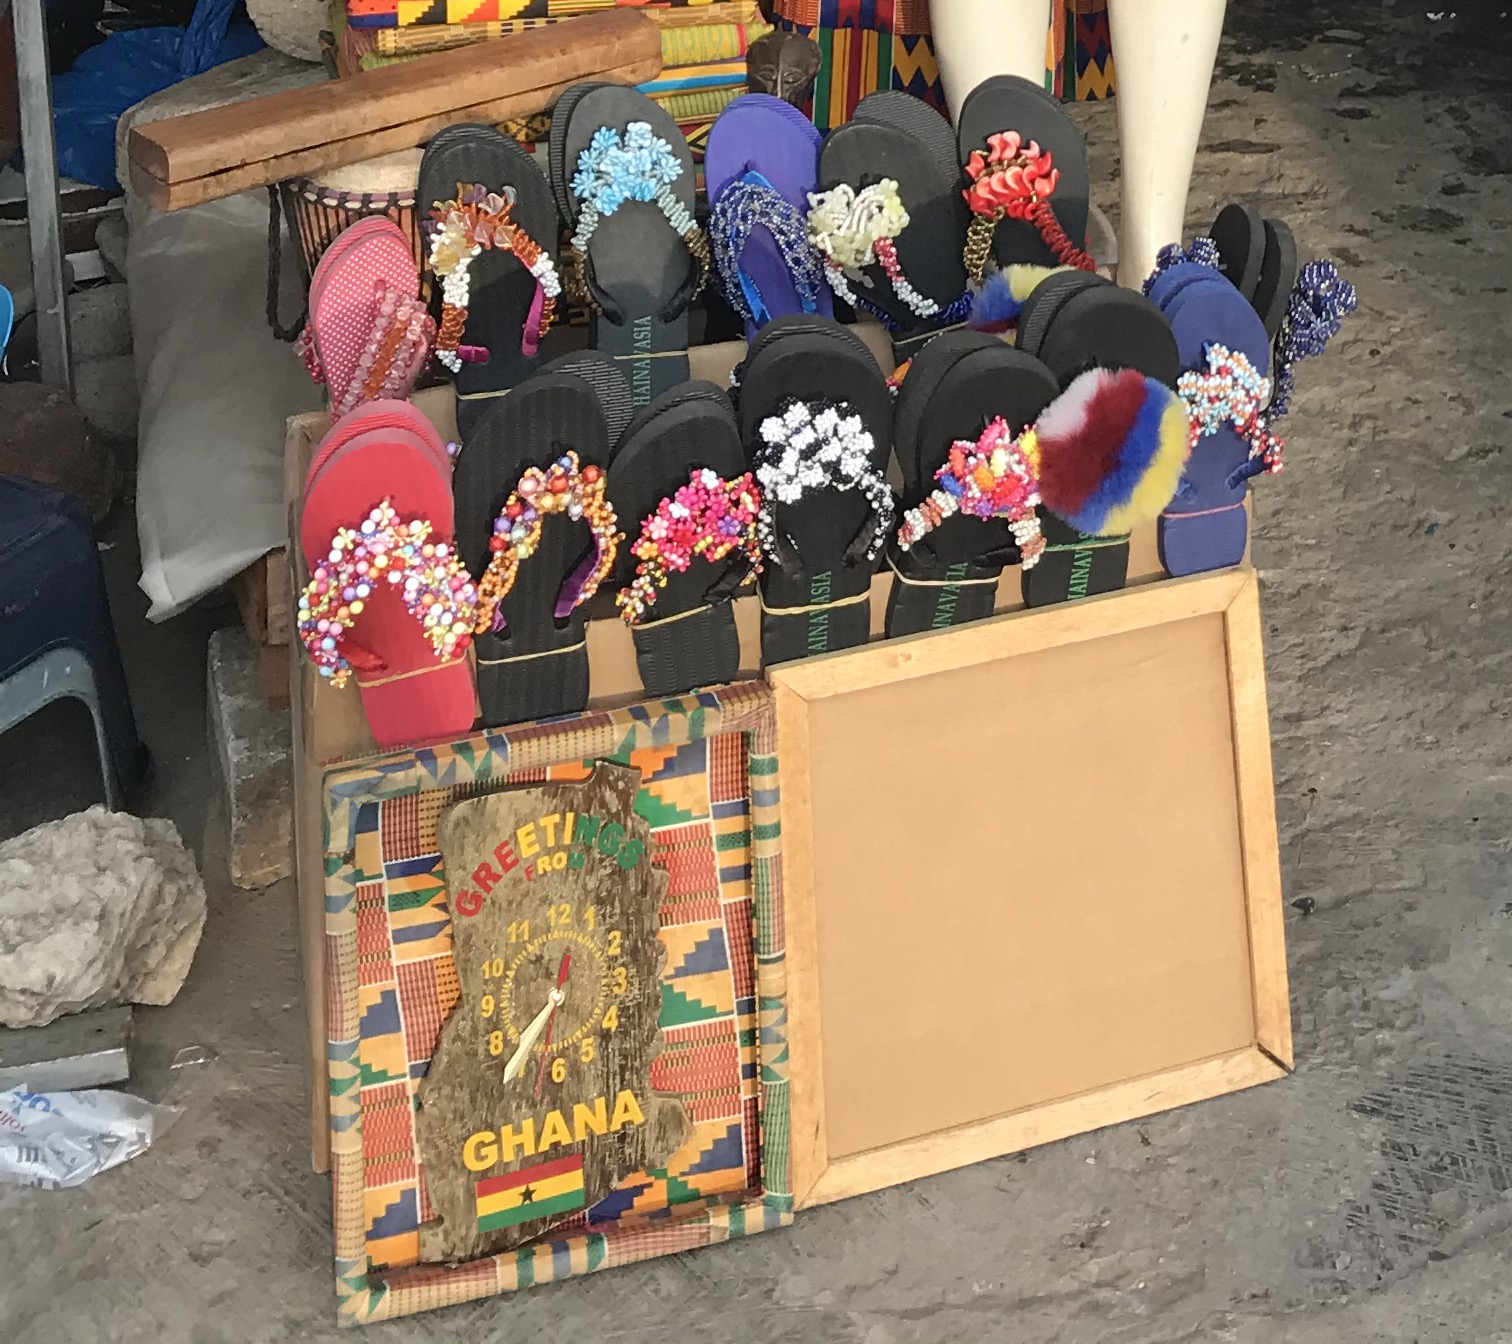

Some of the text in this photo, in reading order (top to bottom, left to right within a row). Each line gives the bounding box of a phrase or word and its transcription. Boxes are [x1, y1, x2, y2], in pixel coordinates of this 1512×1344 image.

[806, 570, 832, 653] AINAASIA
[455, 811, 645, 918] GREETINGS
[547, 903, 572, 927] 12
[584, 905, 597, 931] 1
[506, 919, 531, 944] 11
[608, 930, 622, 956] 2
[481, 957, 505, 980] 10
[612, 967, 628, 995] 3
[481, 994, 495, 1019] 9
[601, 1005, 619, 1033] 4
[489, 1030, 504, 1057] 8
[580, 1037, 595, 1063] 5
[551, 1057, 567, 1084] 6
[462, 1088, 645, 1172] GHANA
